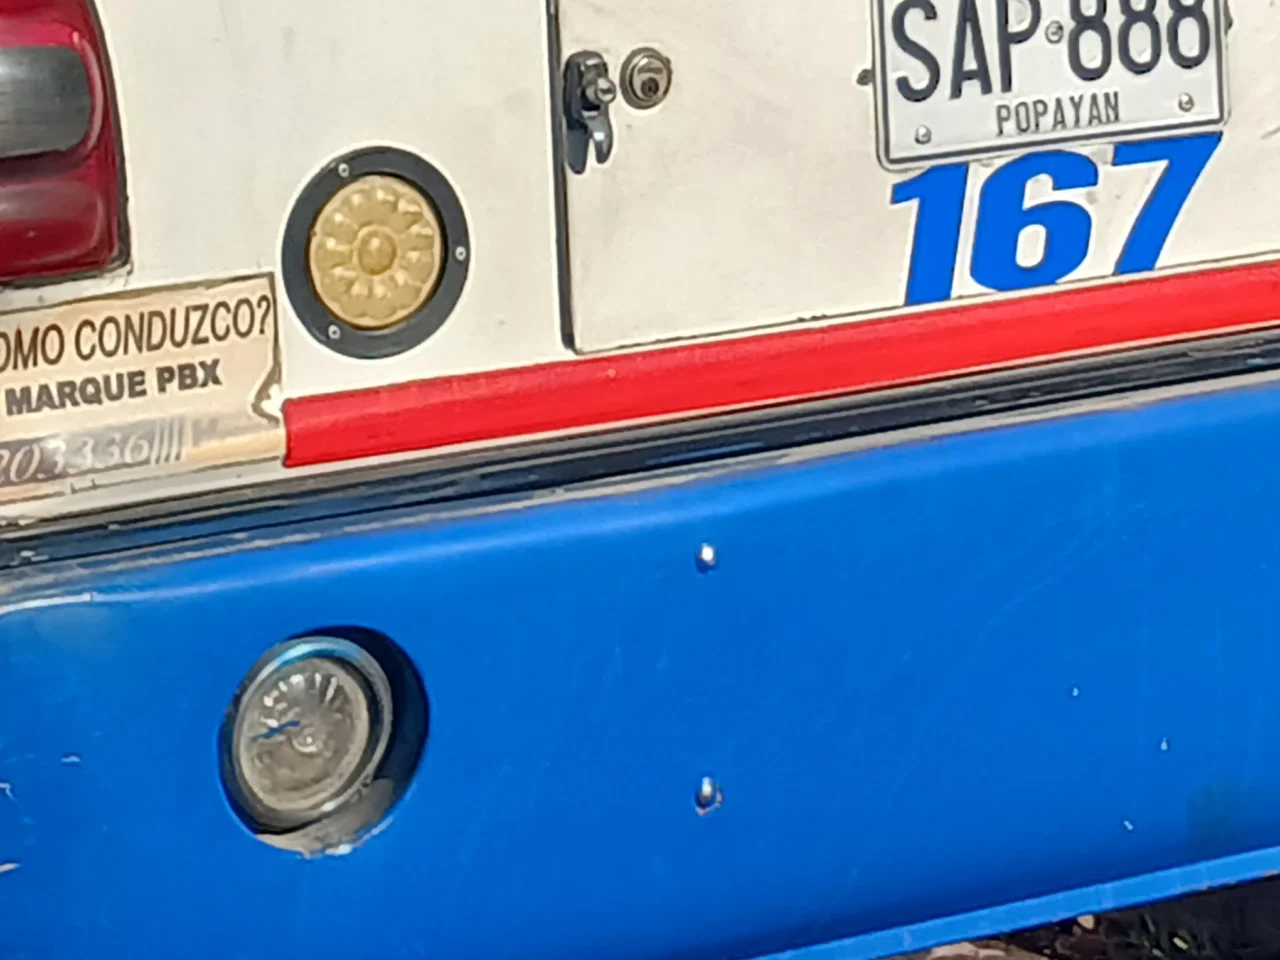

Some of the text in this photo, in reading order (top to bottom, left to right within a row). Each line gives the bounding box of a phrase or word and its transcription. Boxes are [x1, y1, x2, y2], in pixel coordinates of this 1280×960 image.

[996, 90, 1120, 136] POPAYAN
[891, 130, 1224, 307] 167
[75, 294, 272, 361] CONDUZCO?
[5, 359, 222, 416] MARQUE PBX
